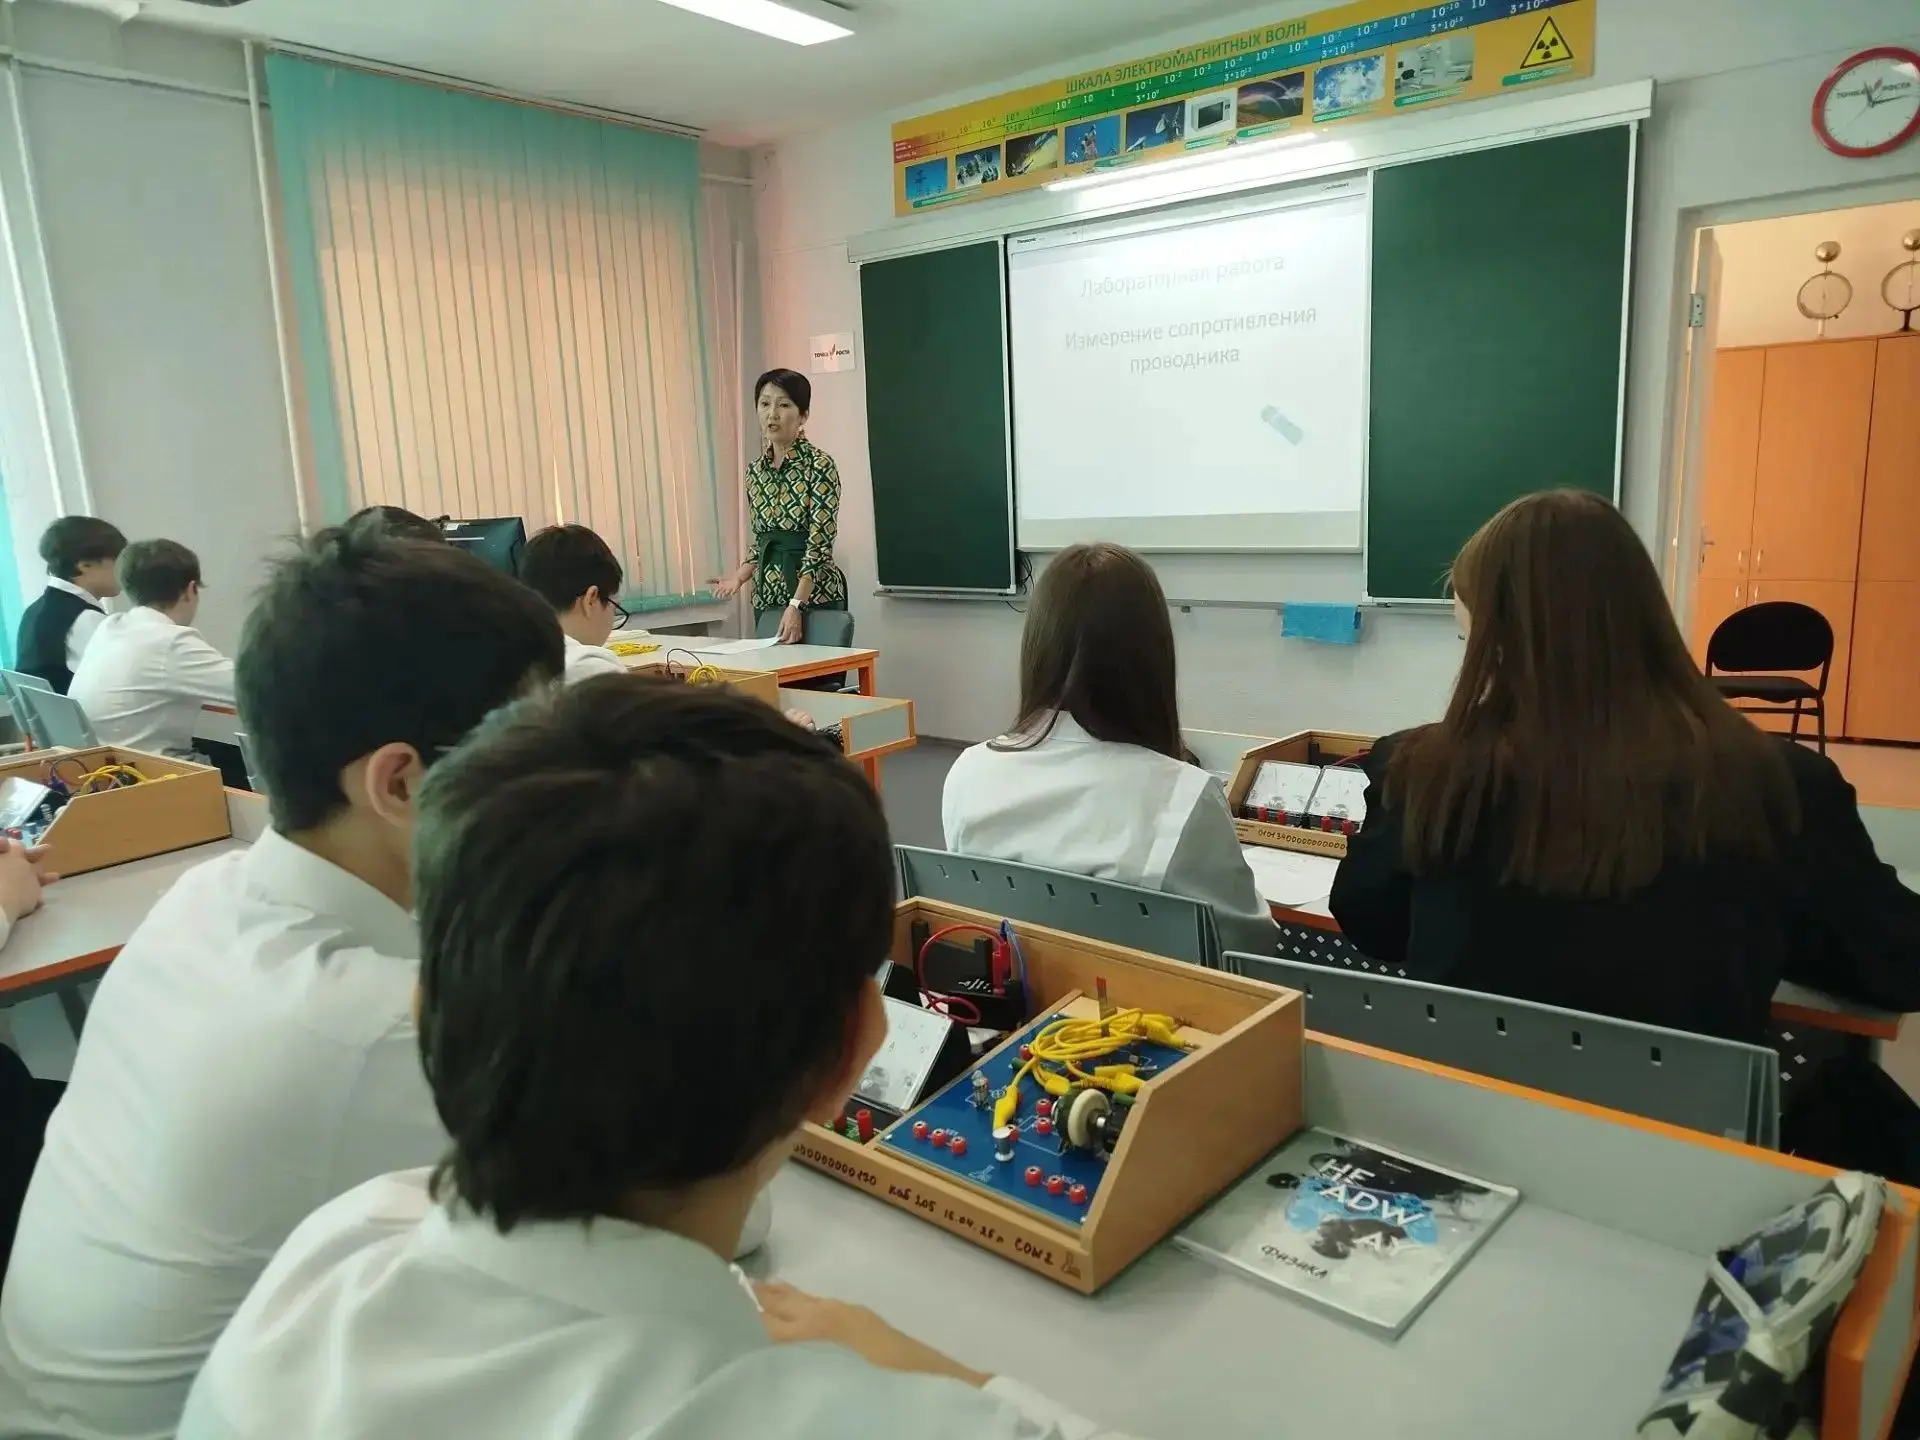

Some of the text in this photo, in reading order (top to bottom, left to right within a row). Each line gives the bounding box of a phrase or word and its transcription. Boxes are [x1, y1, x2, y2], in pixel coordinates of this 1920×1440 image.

[1065, 20, 1308, 94] ШКАЛА ЭЛЕКТРОМАГНИТНЫХ ВОЛН
[1216, 254, 1285, 284] работа
[1064, 306, 1317, 351] Измерение сопротивления
[1130, 346, 1241, 376] проводника
[1319, 1183, 1425, 1227] ADW
[1260, 1244, 1329, 1280] ФИЗИКА
